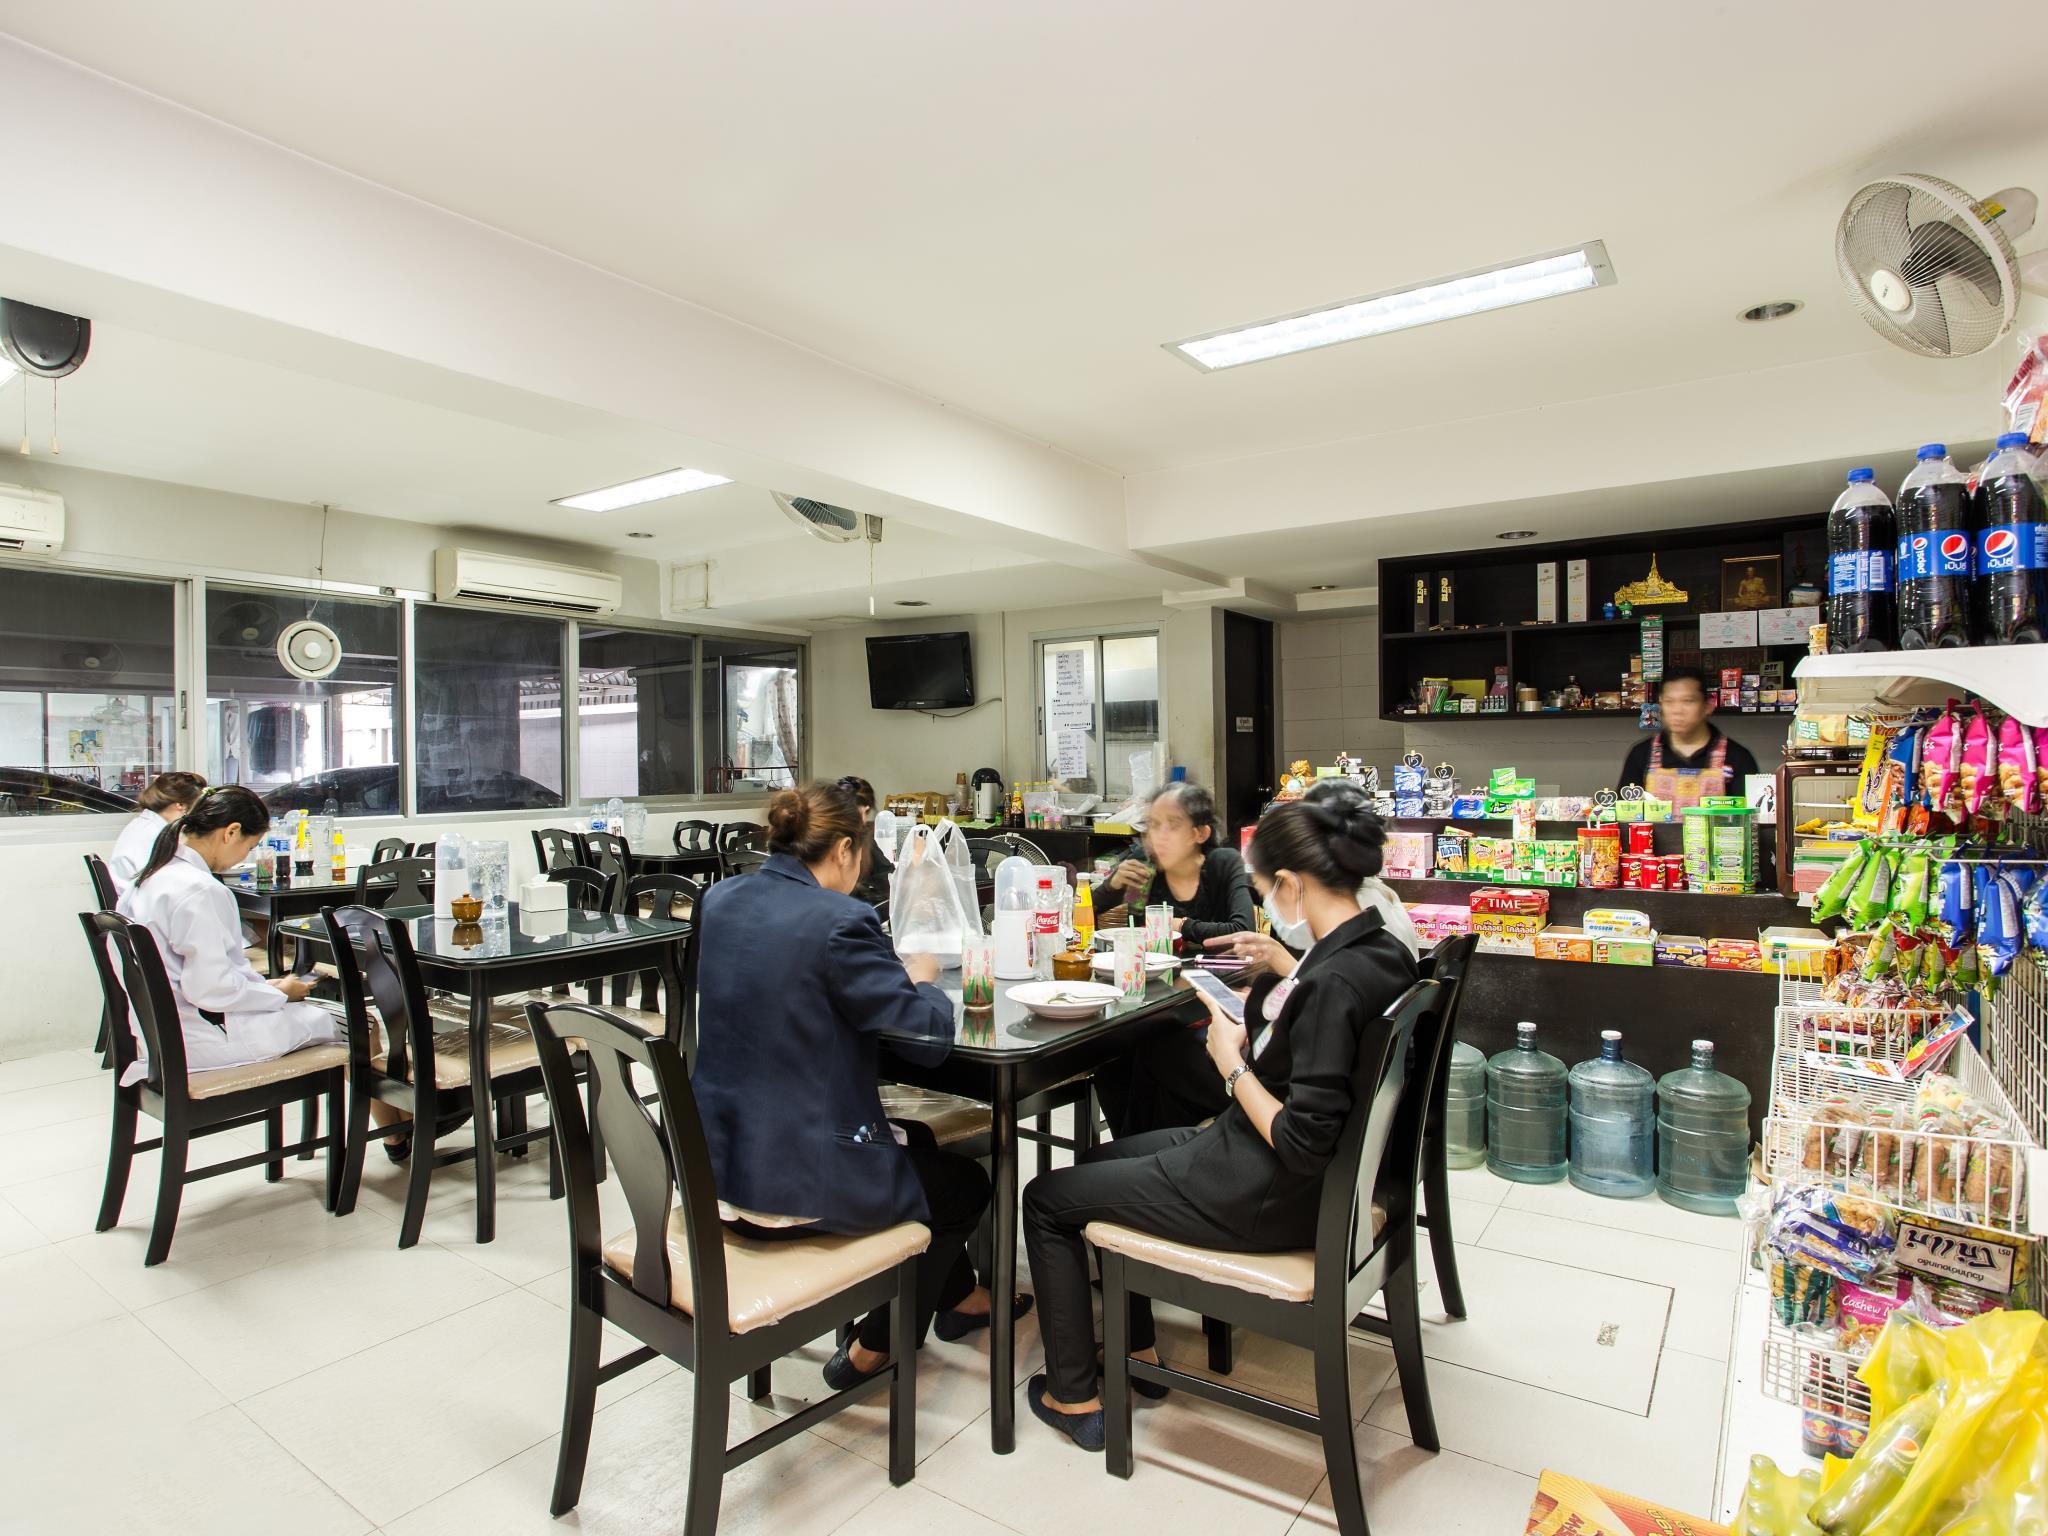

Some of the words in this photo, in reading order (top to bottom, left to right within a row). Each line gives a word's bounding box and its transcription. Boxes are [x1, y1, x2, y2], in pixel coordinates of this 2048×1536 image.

[1917, 549, 1926, 574] pepsi
[1407, 756, 1419, 767] 15
[1437, 768, 1450, 778] 12
[1600, 794, 1614, 806] 22
[1487, 897, 1522, 910] TIME
[1036, 914, 1059, 927] Coca-Cola
[1842, 1294, 1881, 1312] Cashew
